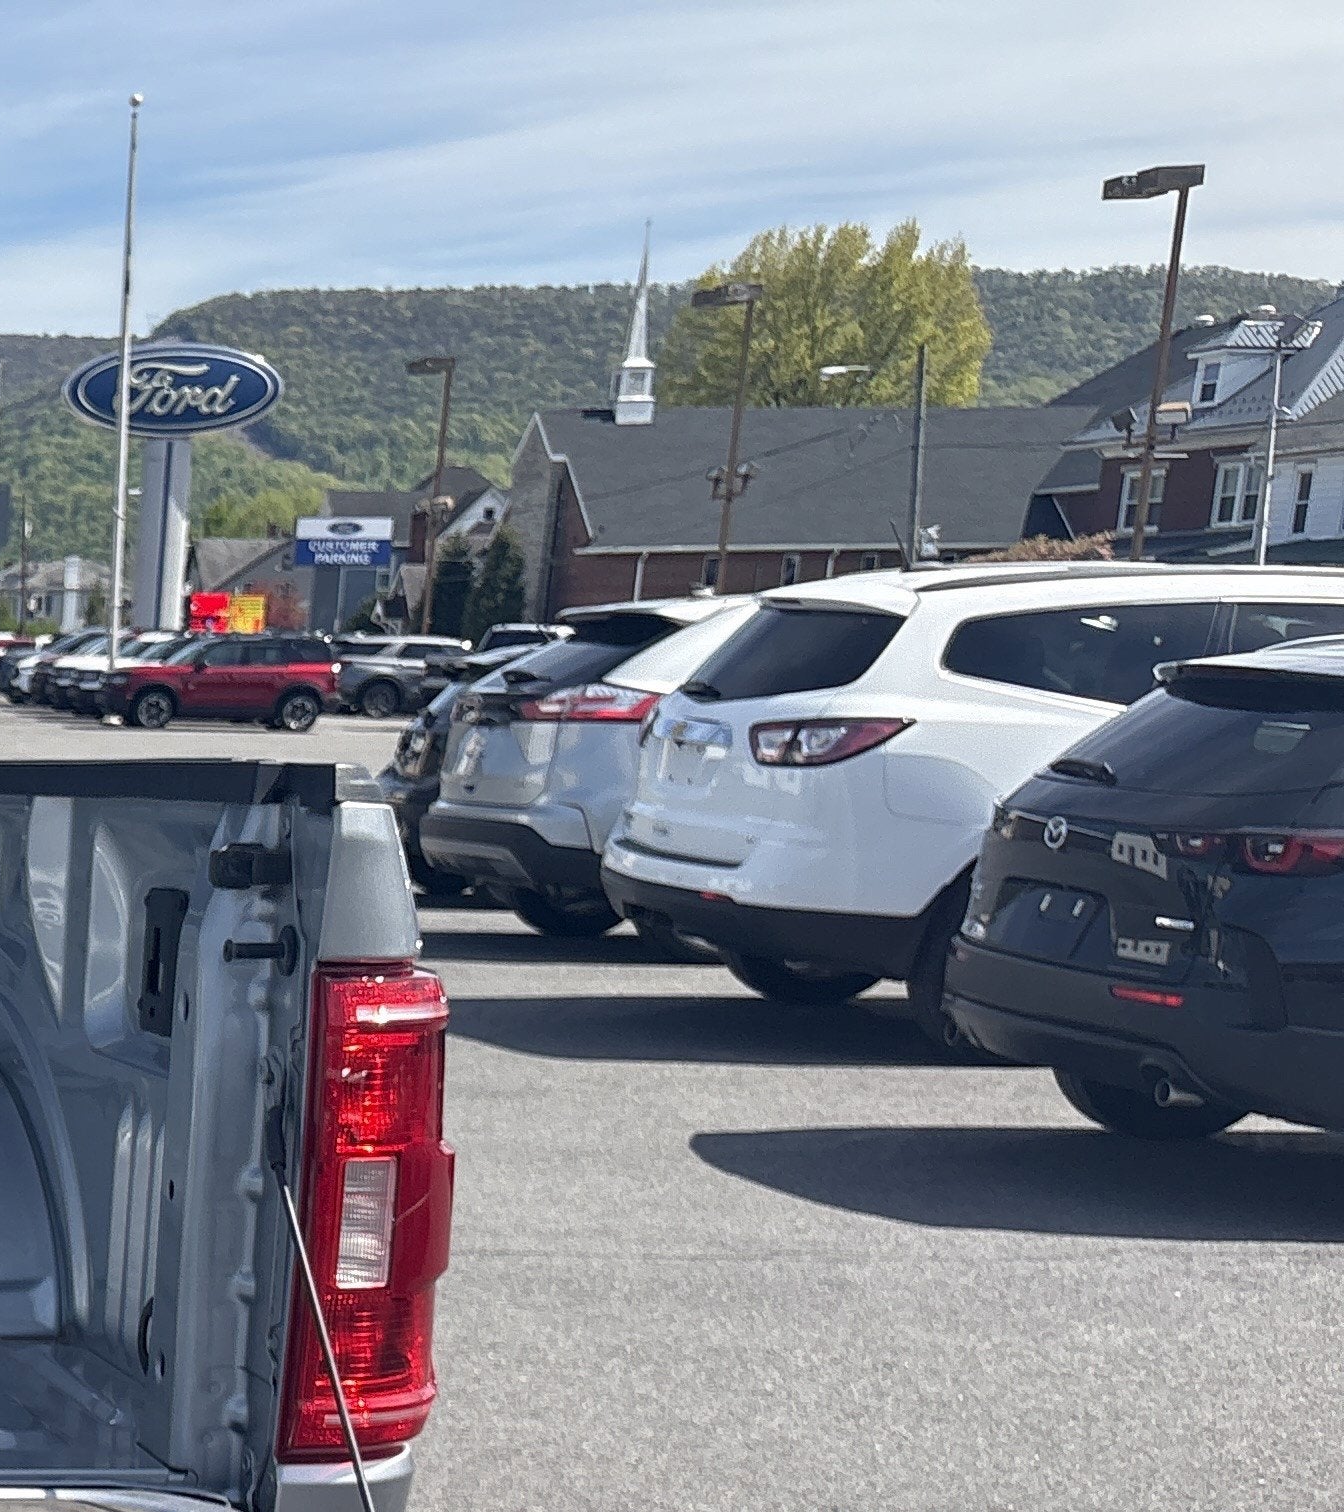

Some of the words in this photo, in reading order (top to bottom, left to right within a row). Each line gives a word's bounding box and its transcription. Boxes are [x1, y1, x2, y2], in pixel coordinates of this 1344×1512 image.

[114, 361, 241, 416] Ford
[308, 540, 379, 553] CUSTOMER
[314, 553, 371, 565] PARKING
